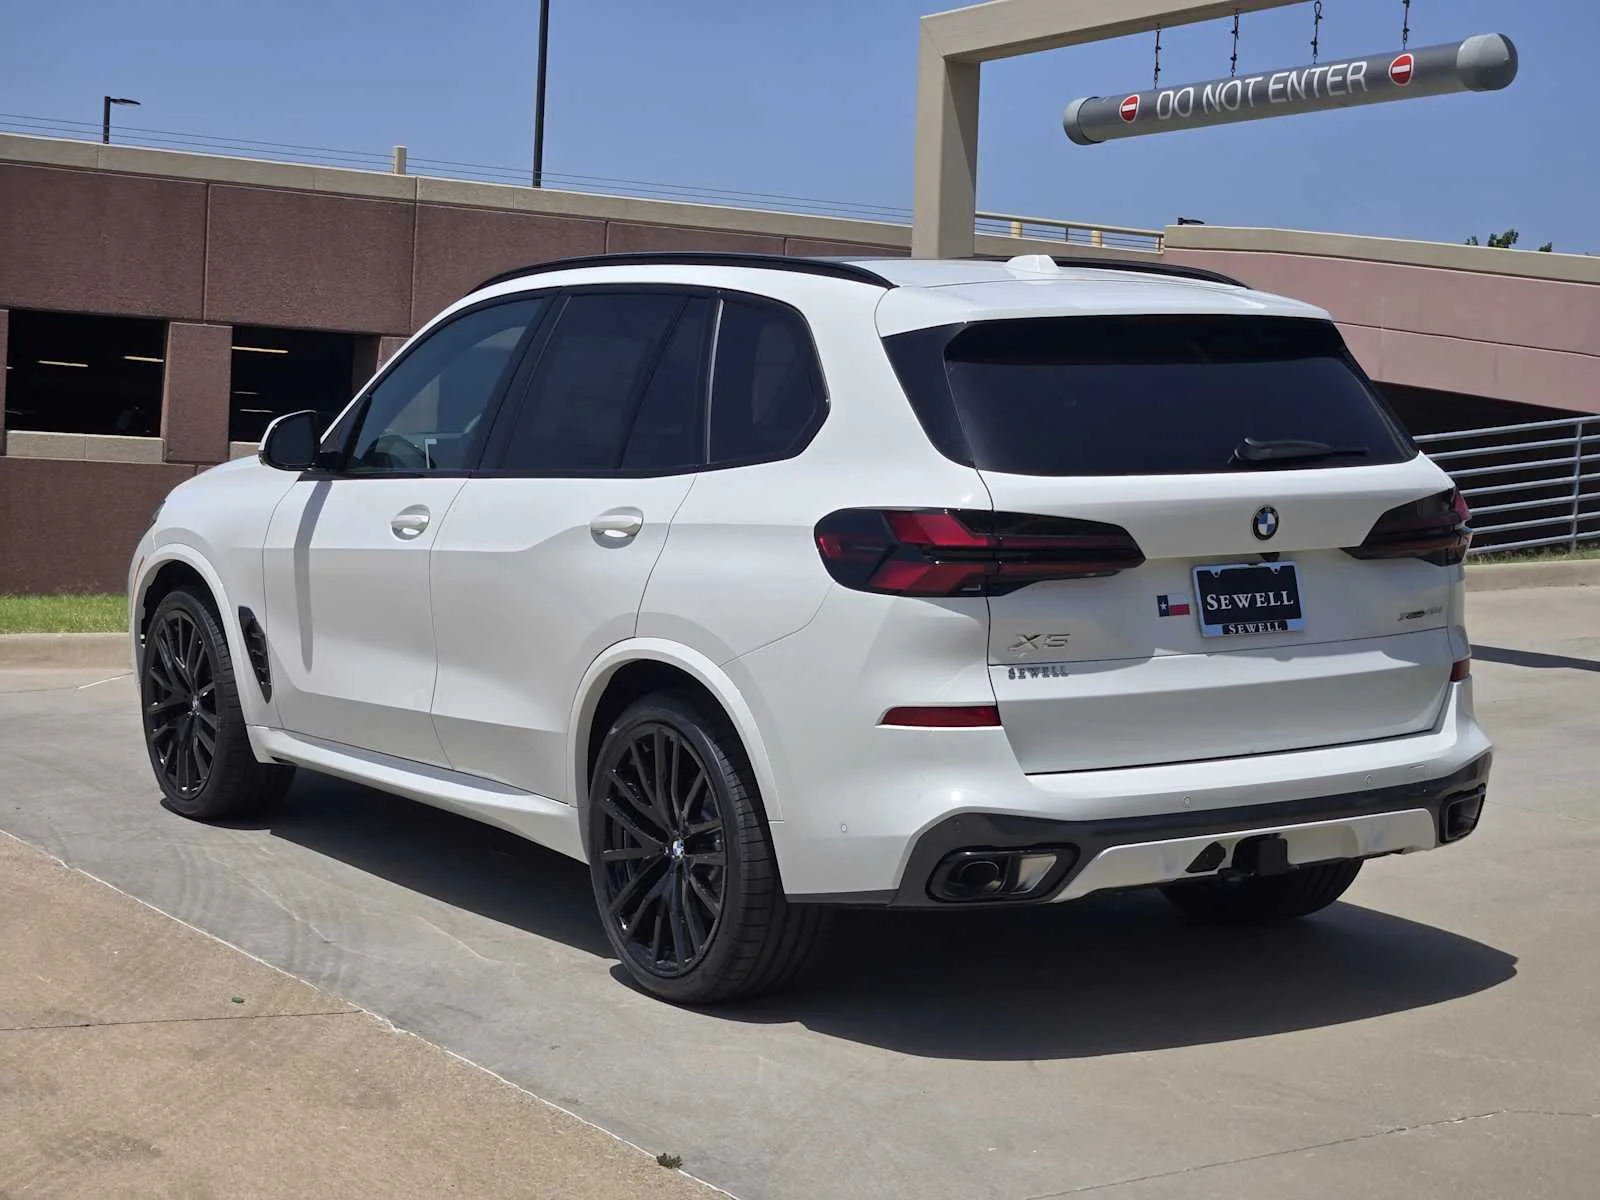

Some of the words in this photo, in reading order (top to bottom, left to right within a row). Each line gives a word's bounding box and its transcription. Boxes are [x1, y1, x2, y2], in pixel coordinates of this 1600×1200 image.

[1156, 86, 1194, 120] DO
[1202, 77, 1263, 113] NOT
[1268, 60, 1368, 104] ENTER
[1206, 590, 1294, 611] SEWELL
[1228, 621, 1283, 635] SEWELL
[1008, 632, 1071, 650] X5
[1008, 665, 1068, 680] SEWELL
